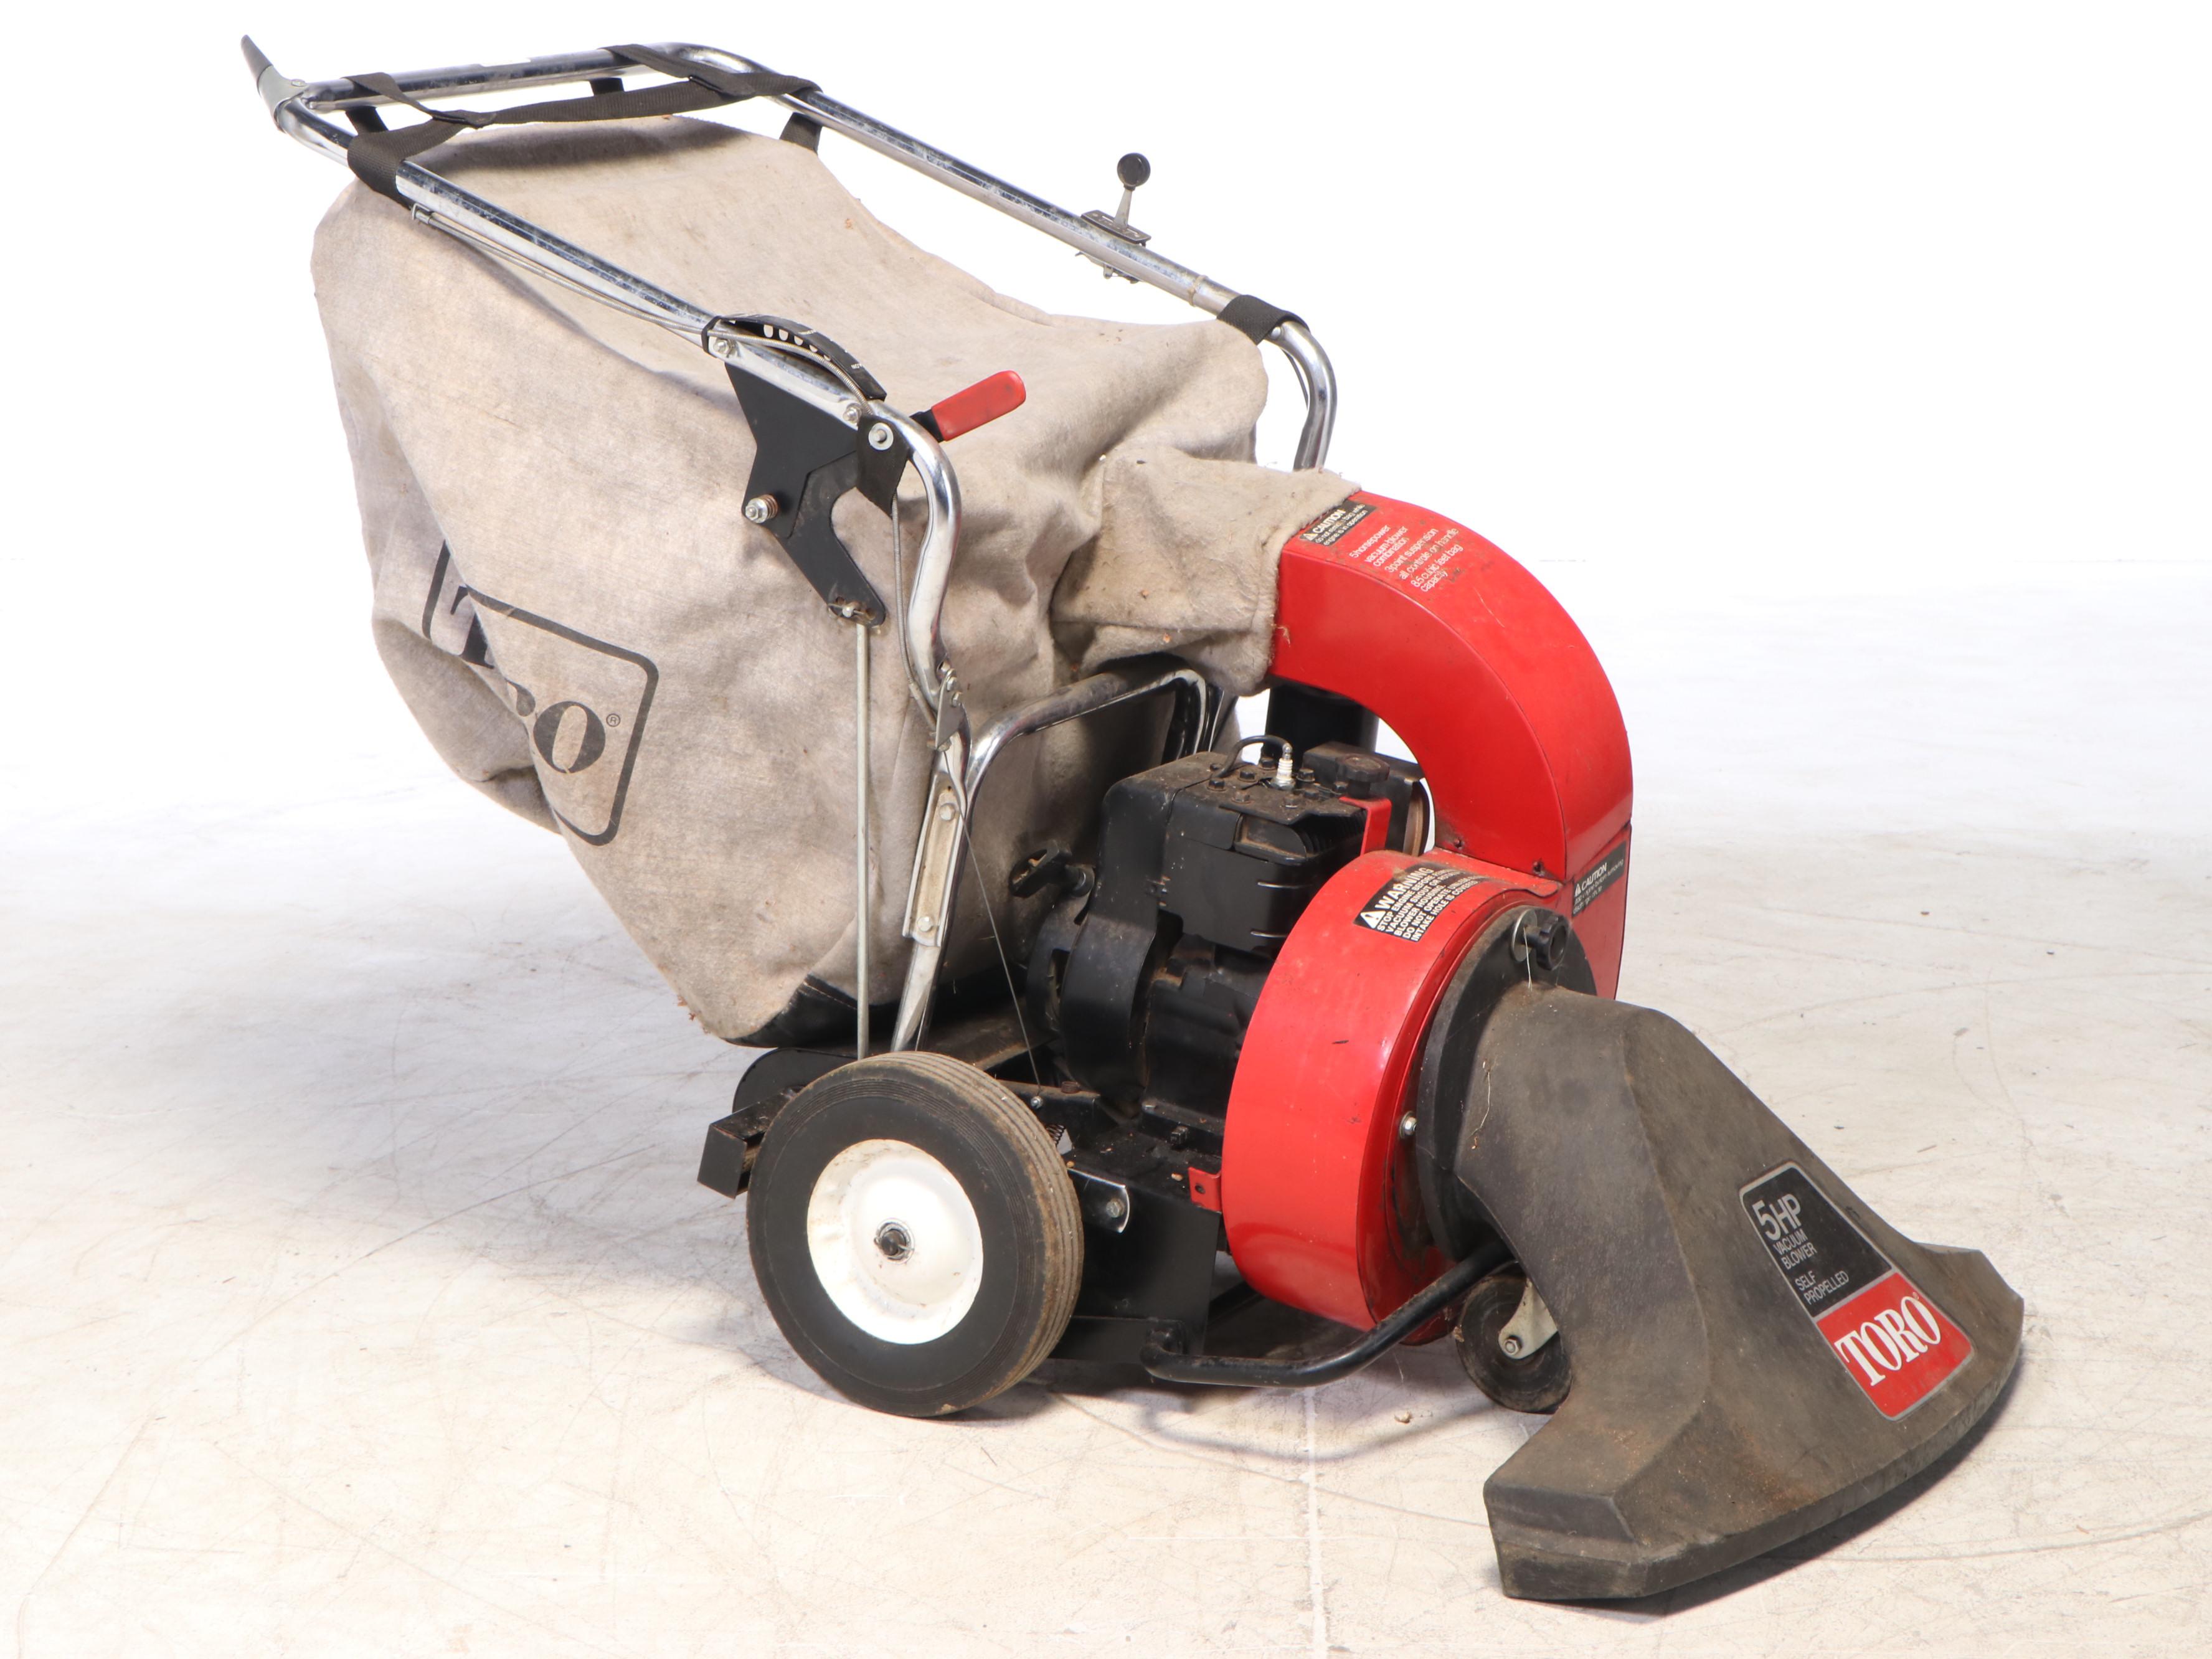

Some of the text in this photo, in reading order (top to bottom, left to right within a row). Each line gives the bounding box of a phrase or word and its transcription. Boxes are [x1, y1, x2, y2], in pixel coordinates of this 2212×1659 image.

[1313, 509, 1346, 534] CAUTION
[1347, 511, 1368, 526] operation
[1373, 539, 1410, 566] combination
[1404, 529, 1439, 555] suspension
[1445, 544, 1463, 556] bag
[1400, 570, 1410, 580] all
[1420, 572, 1448, 592] capacity
[1374, 868, 1434, 909] WARNING
[1582, 862, 1606, 891] CAUTION
[1378, 912, 1394, 931] STOP
[1391, 890, 1416, 911] ENGINE
[1385, 902, 1414, 931] VACUUM
[1409, 886, 1432, 902] SNOUT
[1394, 907, 1420, 935] BLOWER
[1402, 927, 1415, 938] DO
[1411, 911, 1426, 926] NOT
[1424, 888, 1452, 910] OPERATE
[1411, 915, 1435, 940] INTAKE
[1430, 899, 1450, 915] HOLE
[1773, 1229, 1808, 1255] VACUUM
[1780, 1242, 1818, 1270] BLOWER
[1794, 1270, 1817, 1292] SELF
[1803, 1270, 1850, 1305] PROPELLED
[1833, 1295, 1942, 1387] TORO
